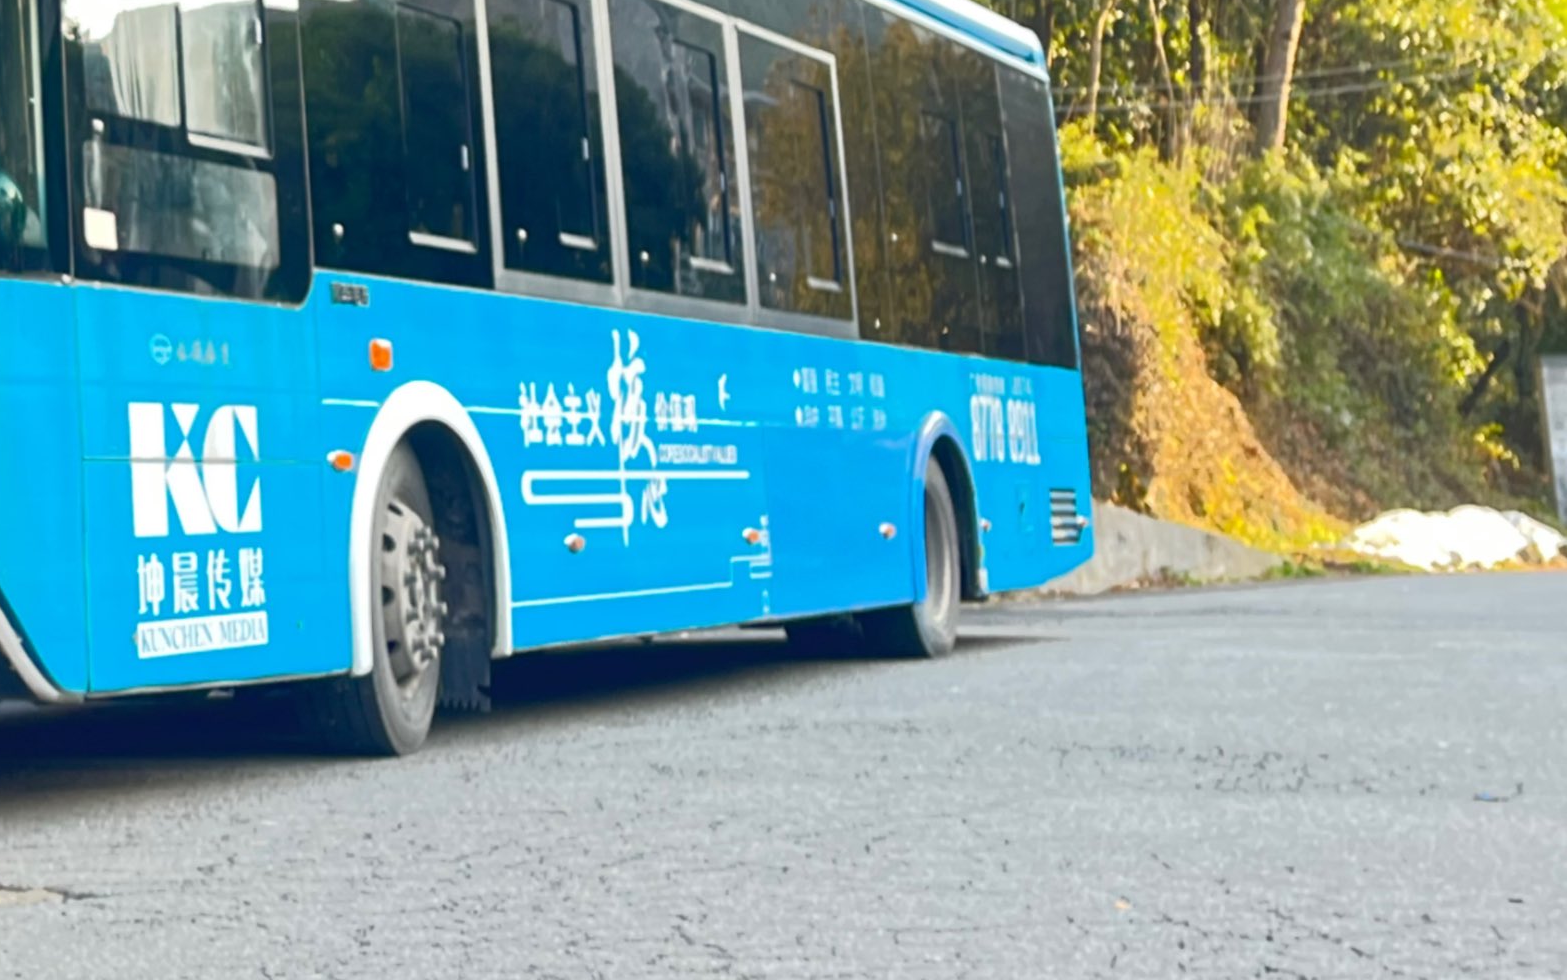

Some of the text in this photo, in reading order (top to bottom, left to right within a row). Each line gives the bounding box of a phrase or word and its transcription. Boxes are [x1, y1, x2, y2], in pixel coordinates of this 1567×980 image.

[127, 402, 262, 537] KC
[136, 546, 267, 617] 坤晨传媒
[139, 617, 266, 655] KUNCHEN MEDIA
